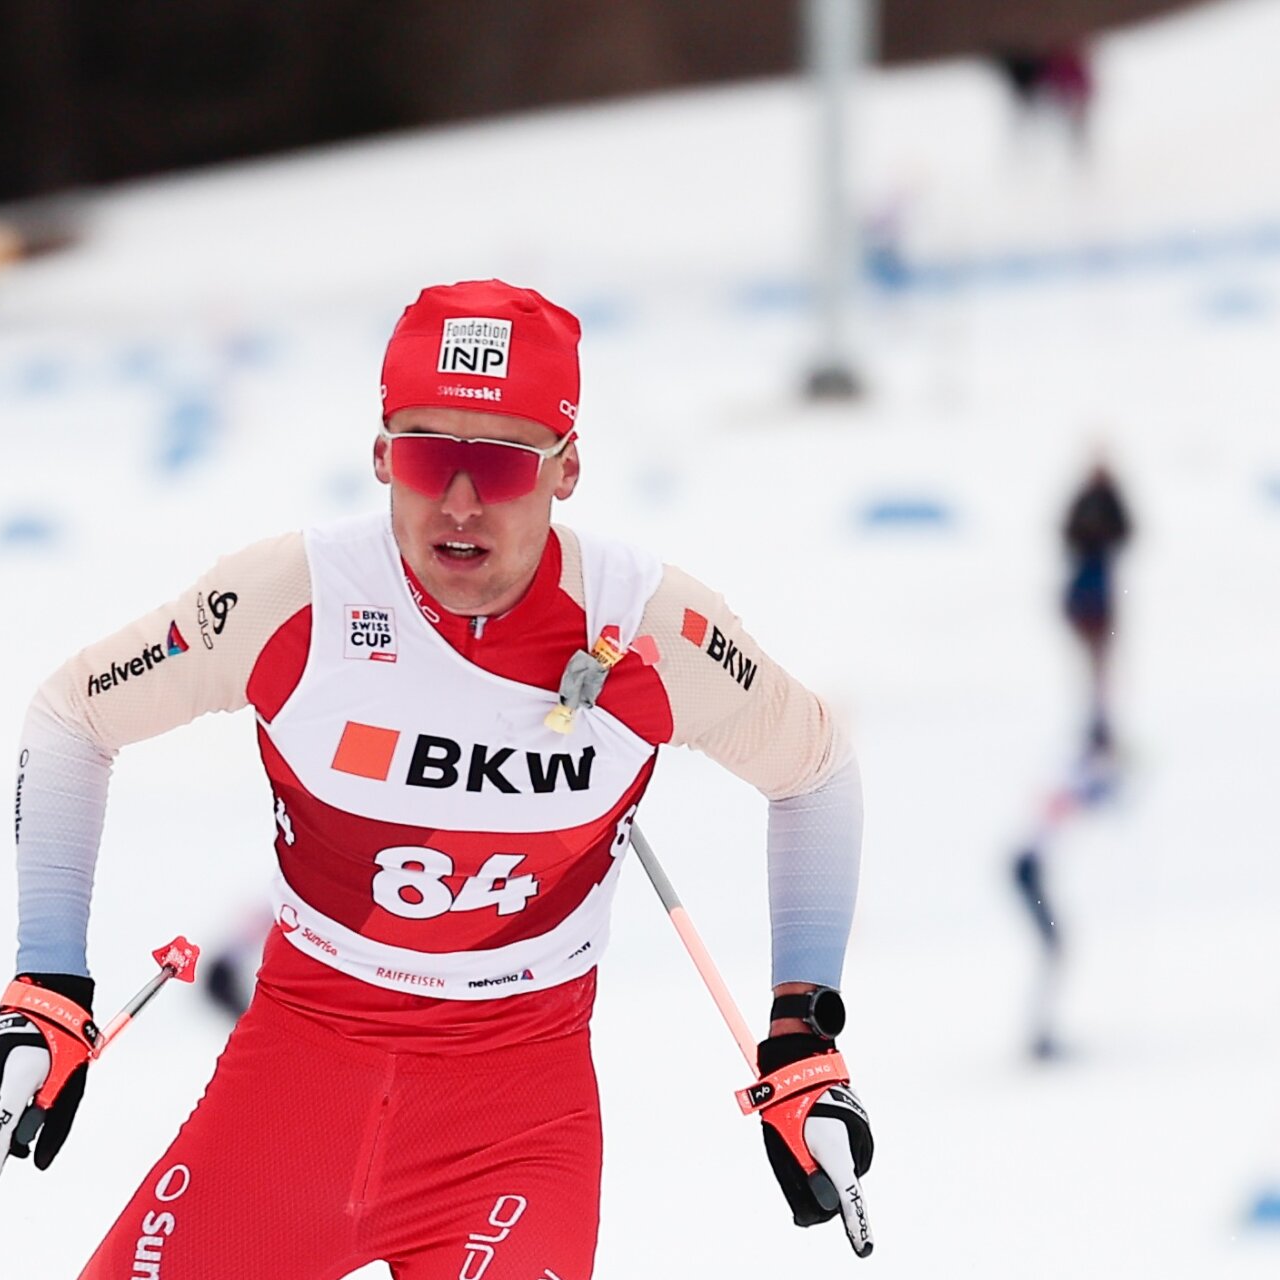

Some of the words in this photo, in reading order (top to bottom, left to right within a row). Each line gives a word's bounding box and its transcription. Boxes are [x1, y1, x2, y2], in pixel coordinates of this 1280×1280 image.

[446, 321, 508, 339] Fondation
[455, 338, 505, 348] GRENOBLE
[442, 346, 504, 373] INP
[362, 610, 388, 621] BKW
[352, 621, 389, 632] SWISS
[351, 631, 392, 648] CUP
[706, 625, 758, 691] BKW
[88, 643, 166, 697] helveta
[405, 733, 596, 795] BKW
[372, 845, 540, 920] 84
[376, 967, 446, 988] RAIFFEISEN
